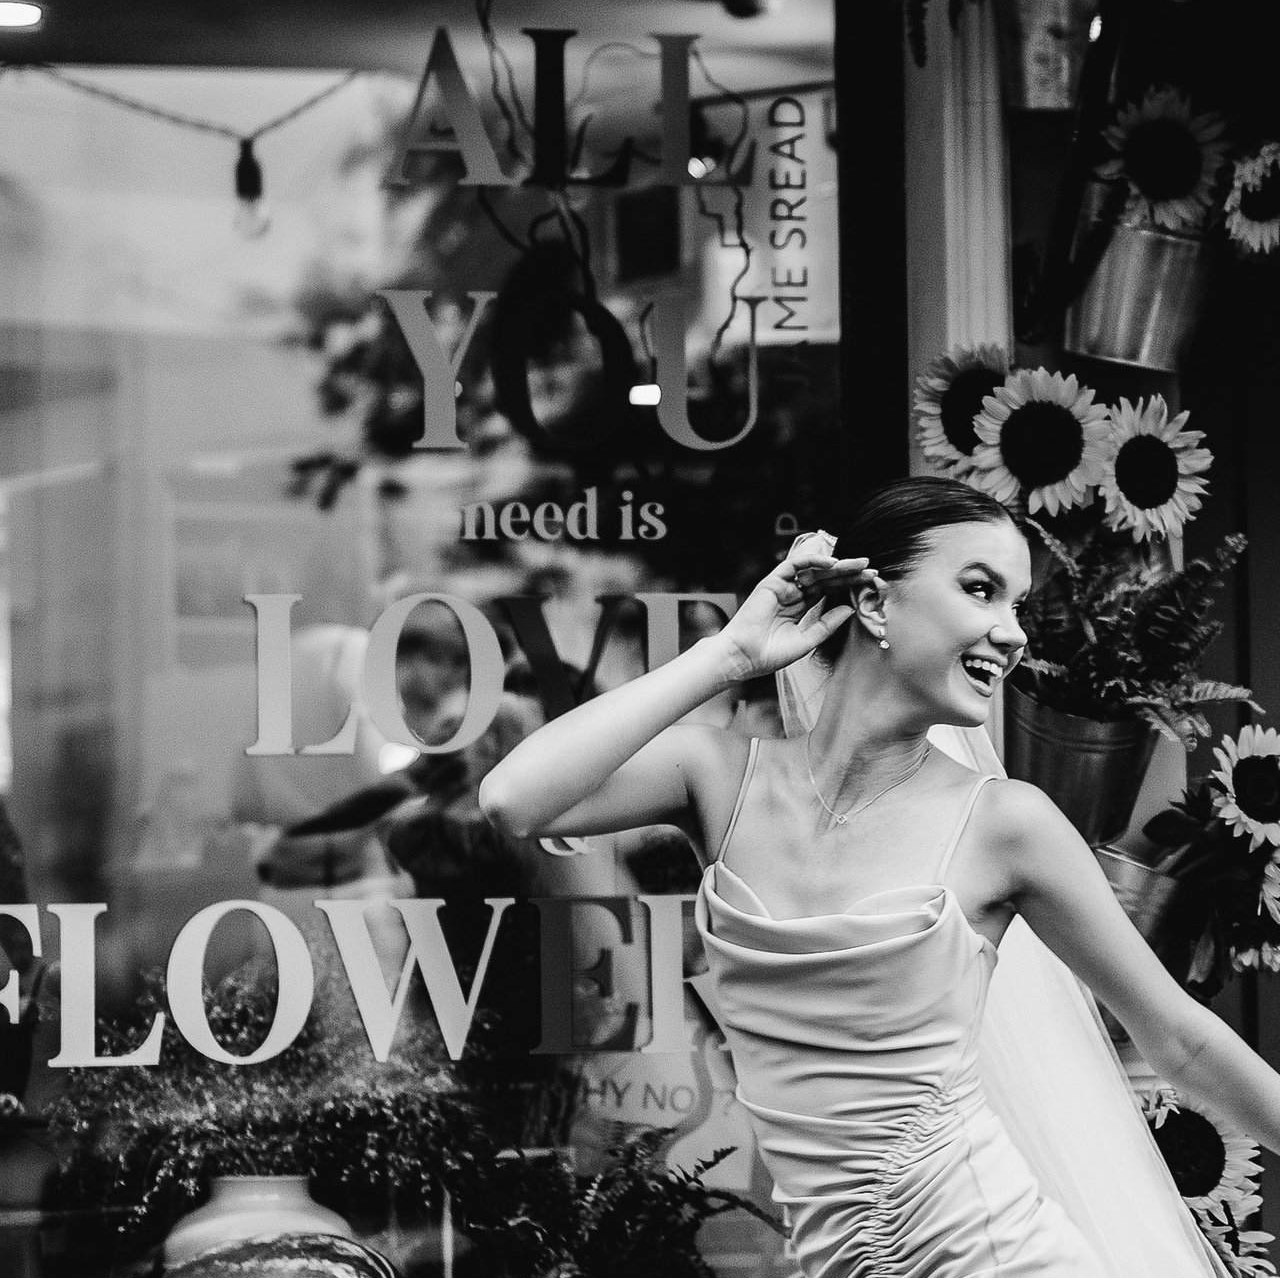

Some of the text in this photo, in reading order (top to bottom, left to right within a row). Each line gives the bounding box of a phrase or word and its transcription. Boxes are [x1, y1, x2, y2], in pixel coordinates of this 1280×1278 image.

[381, 24, 756, 188] ALL
[374, 289, 769, 451] YOU
[461, 486, 668, 540] need is
